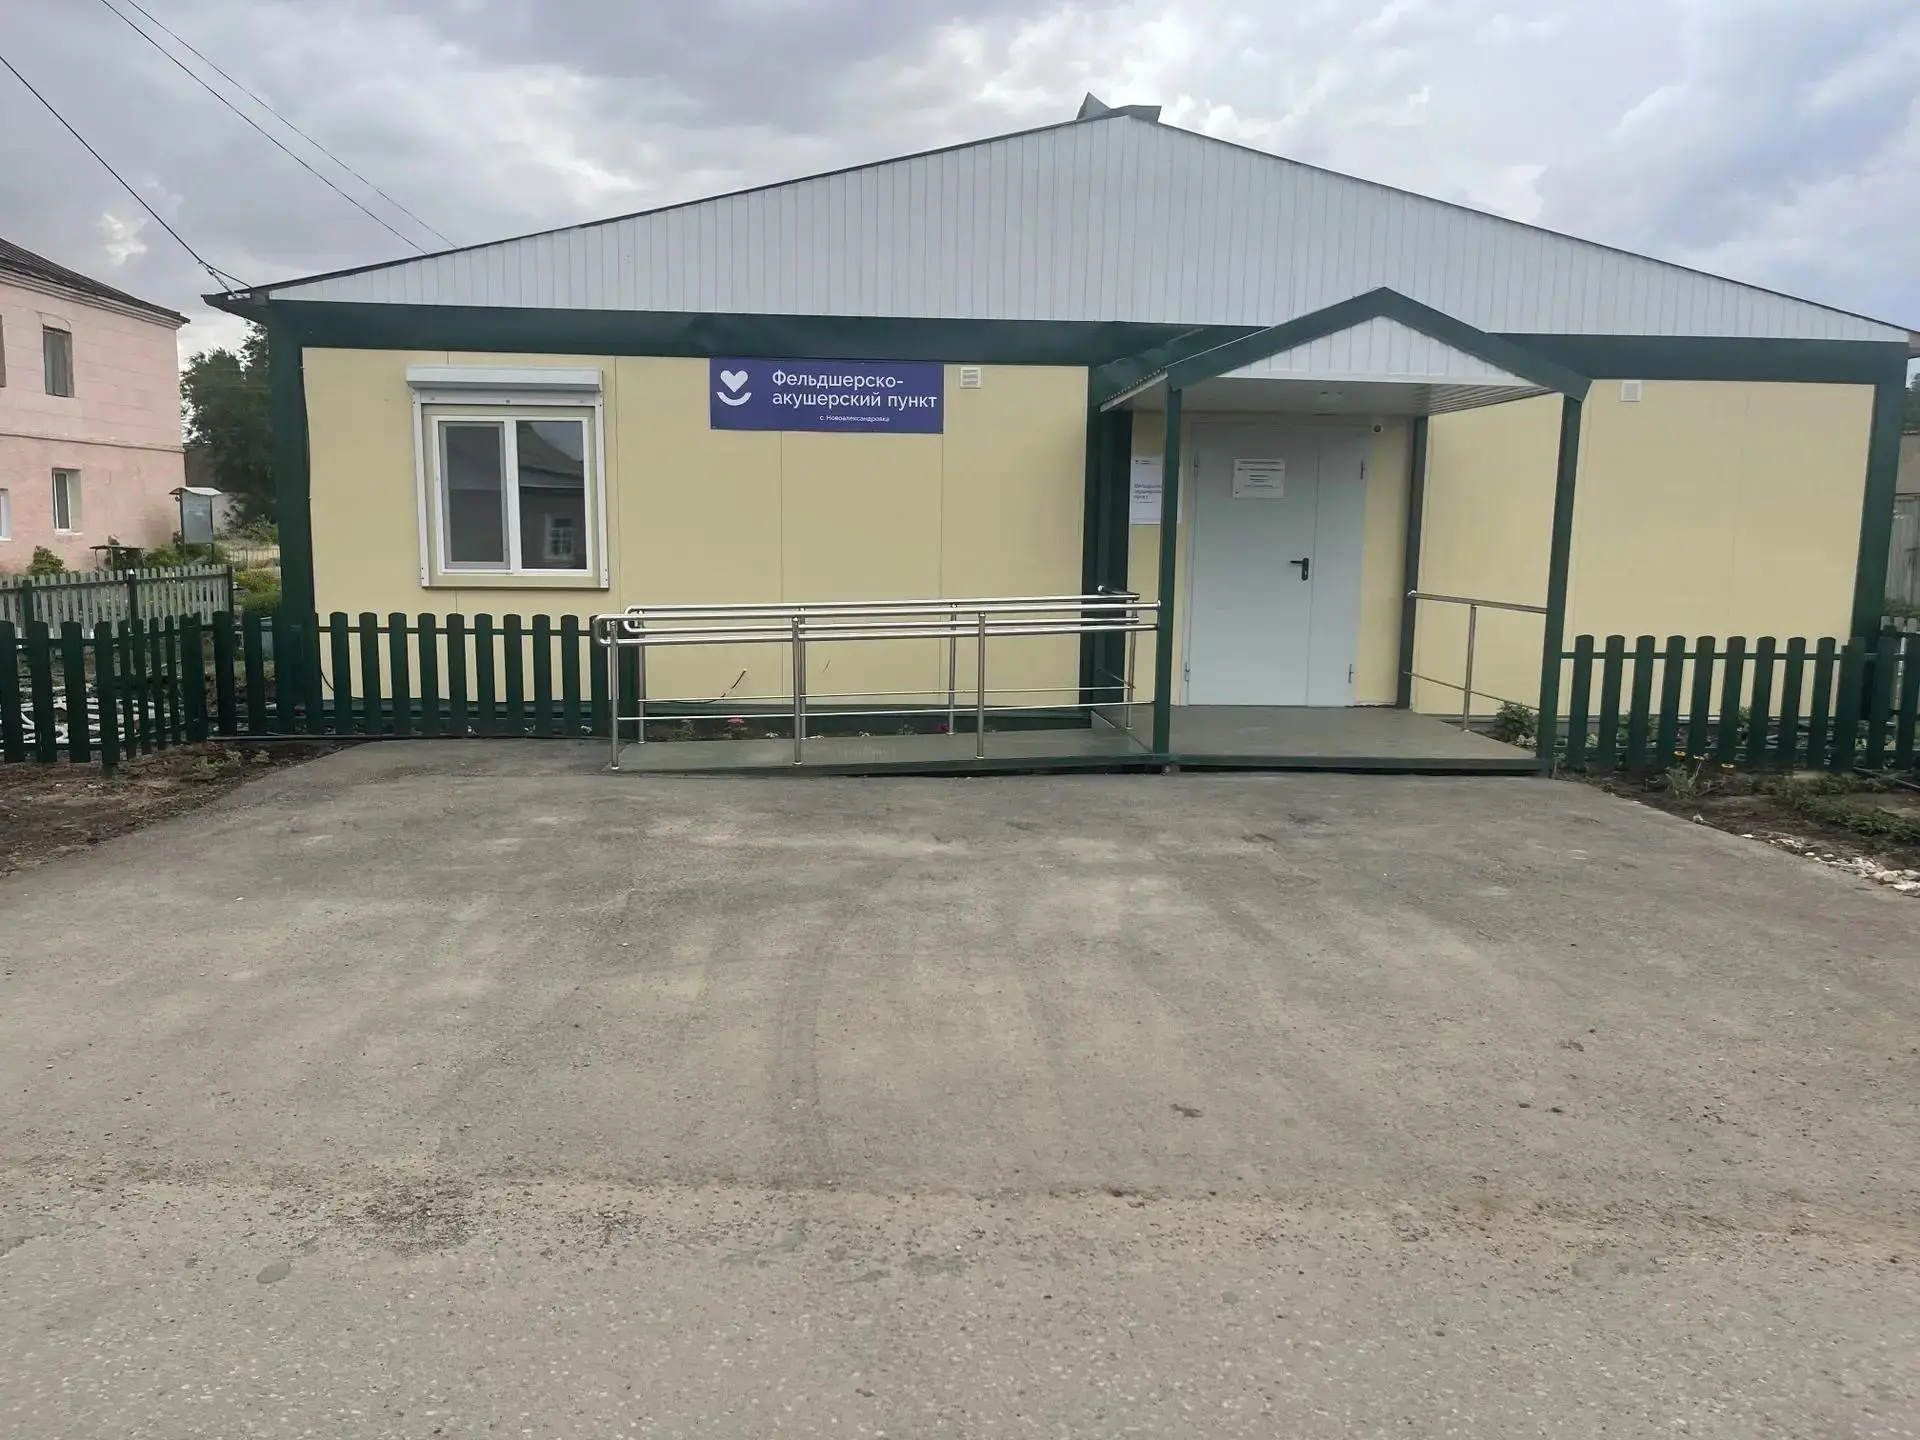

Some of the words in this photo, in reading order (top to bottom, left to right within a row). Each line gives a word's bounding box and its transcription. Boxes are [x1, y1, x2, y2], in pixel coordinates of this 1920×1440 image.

[772, 370, 904, 391] Фельдшерско-
[772, 392, 881, 409] акушерский
[887, 395, 938, 411] пункт
